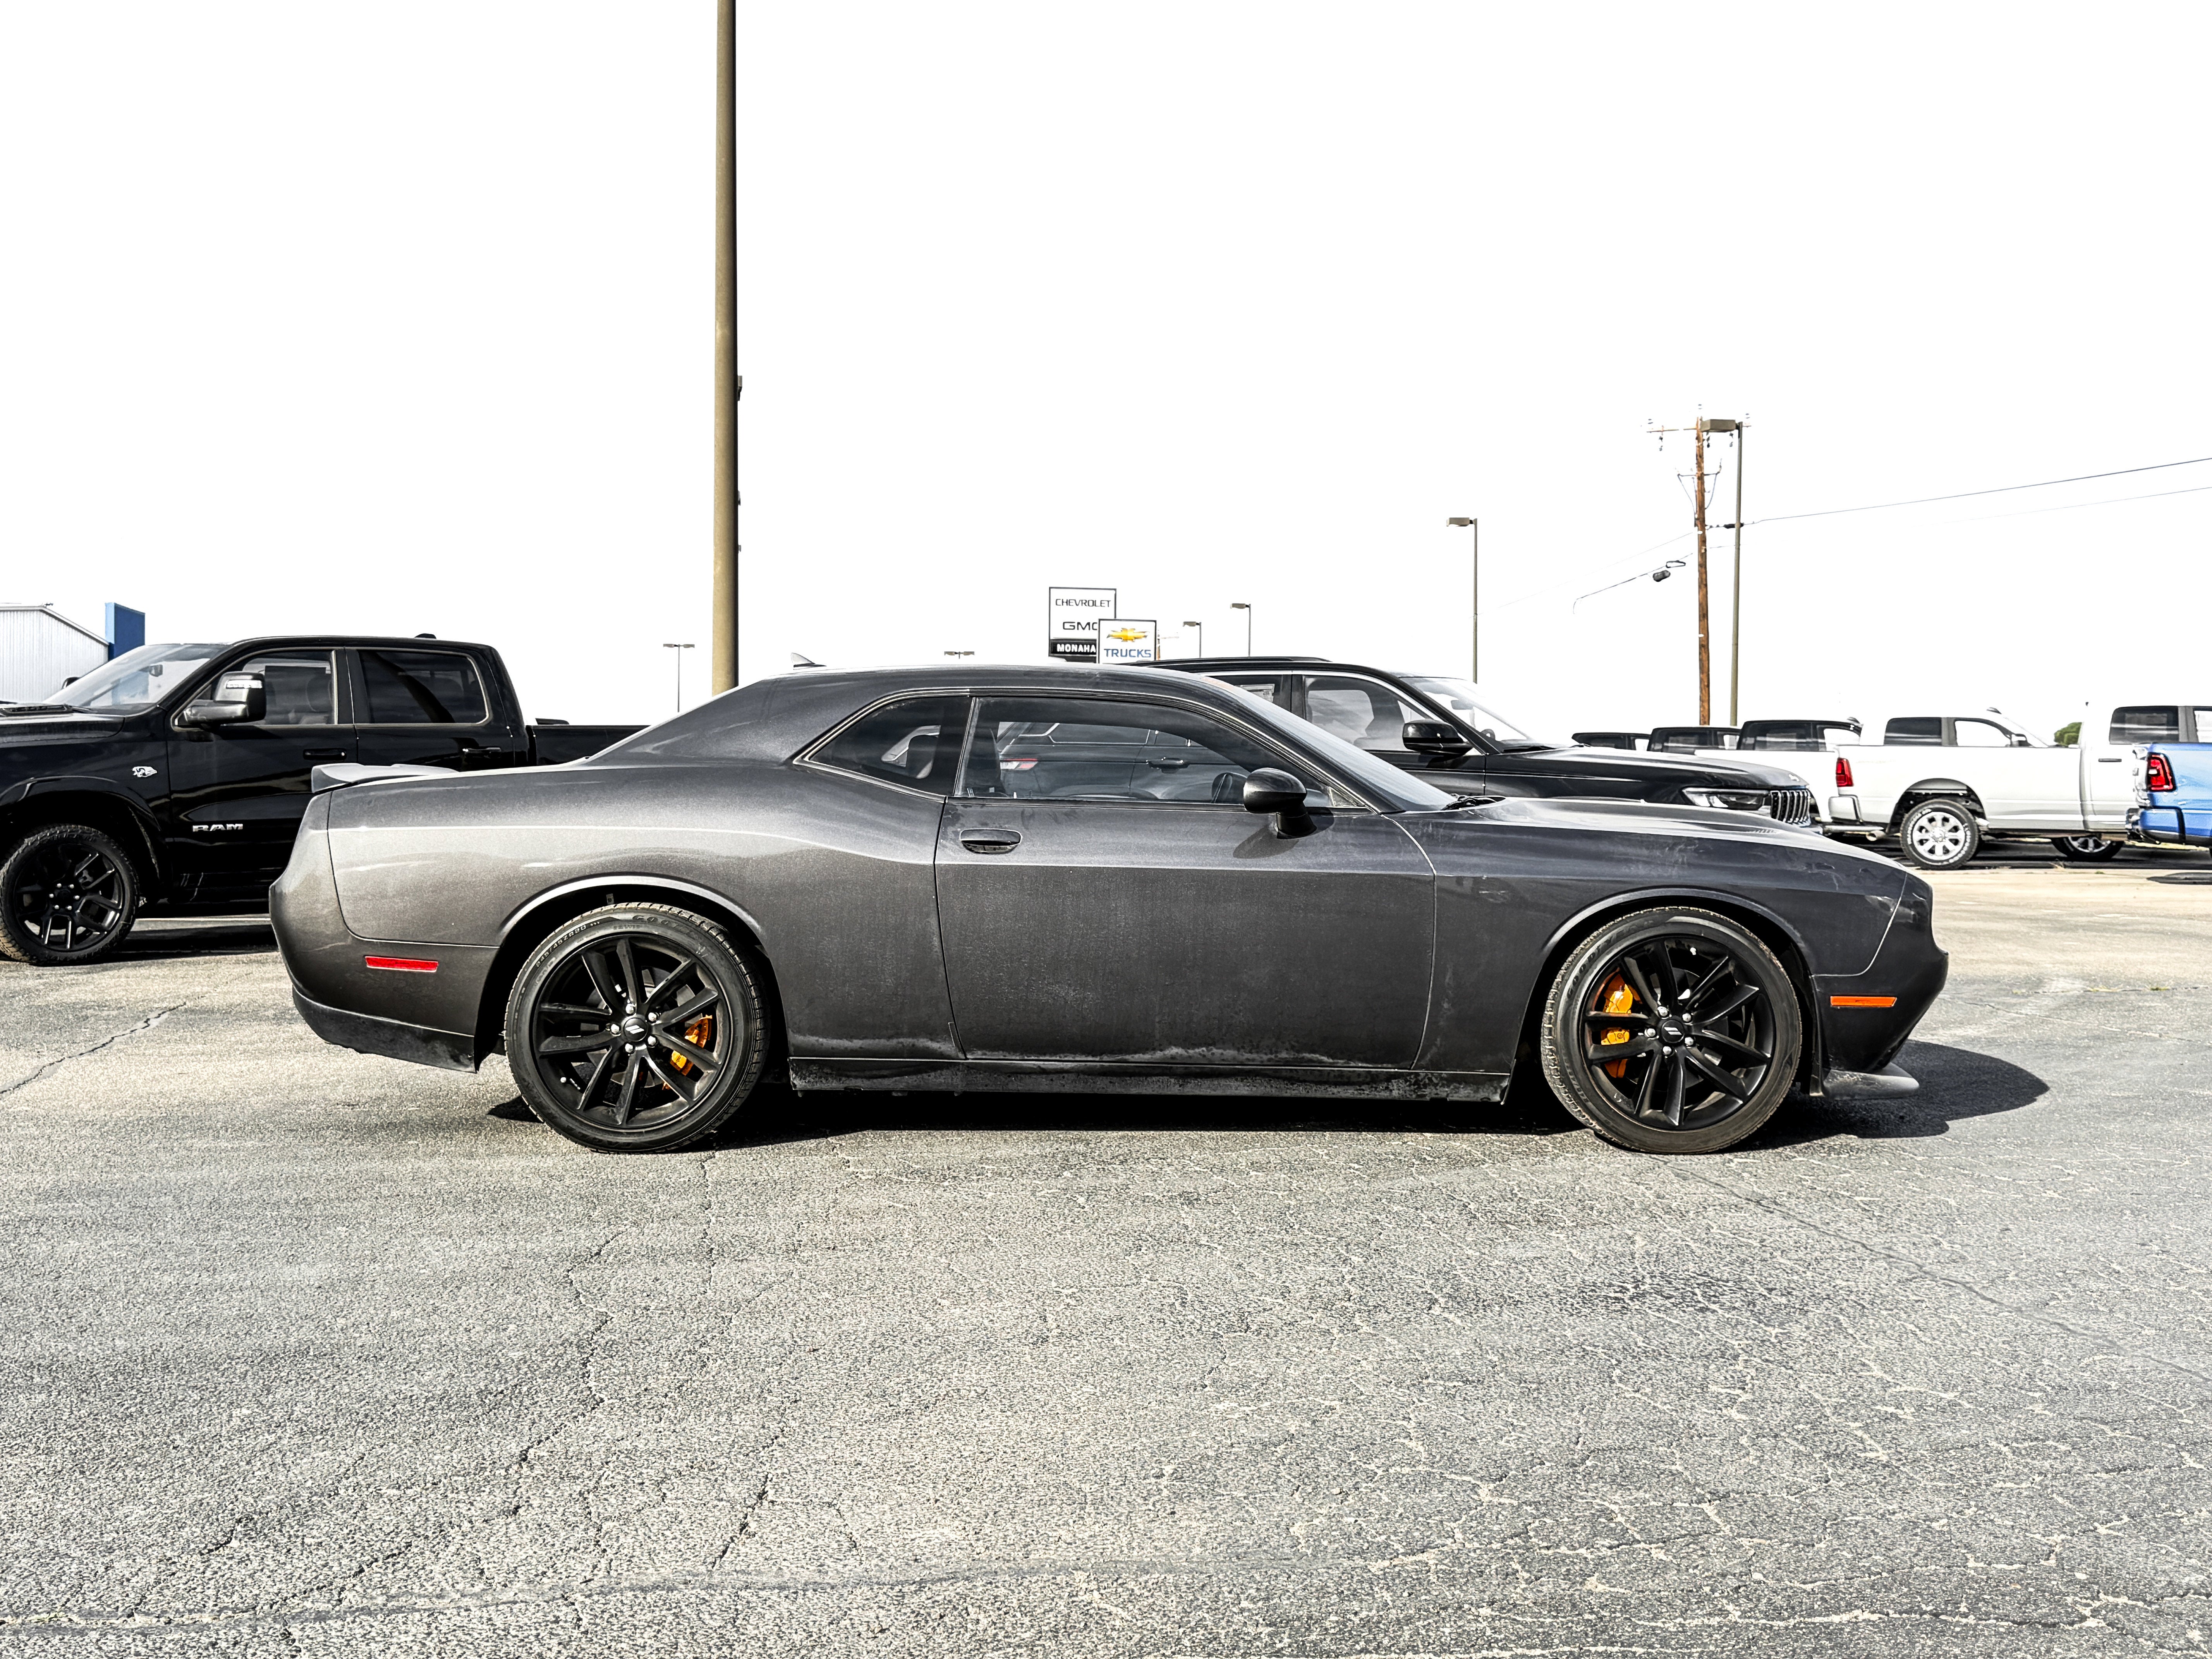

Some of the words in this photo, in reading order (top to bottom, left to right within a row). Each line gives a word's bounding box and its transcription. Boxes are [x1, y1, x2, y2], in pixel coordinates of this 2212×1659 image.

[1055, 599, 1111, 607] CHEVROLET
[1063, 622, 1097, 630] GMC
[1104, 649, 1151, 658] TRUCKS
[192, 823, 243, 831] RAM
